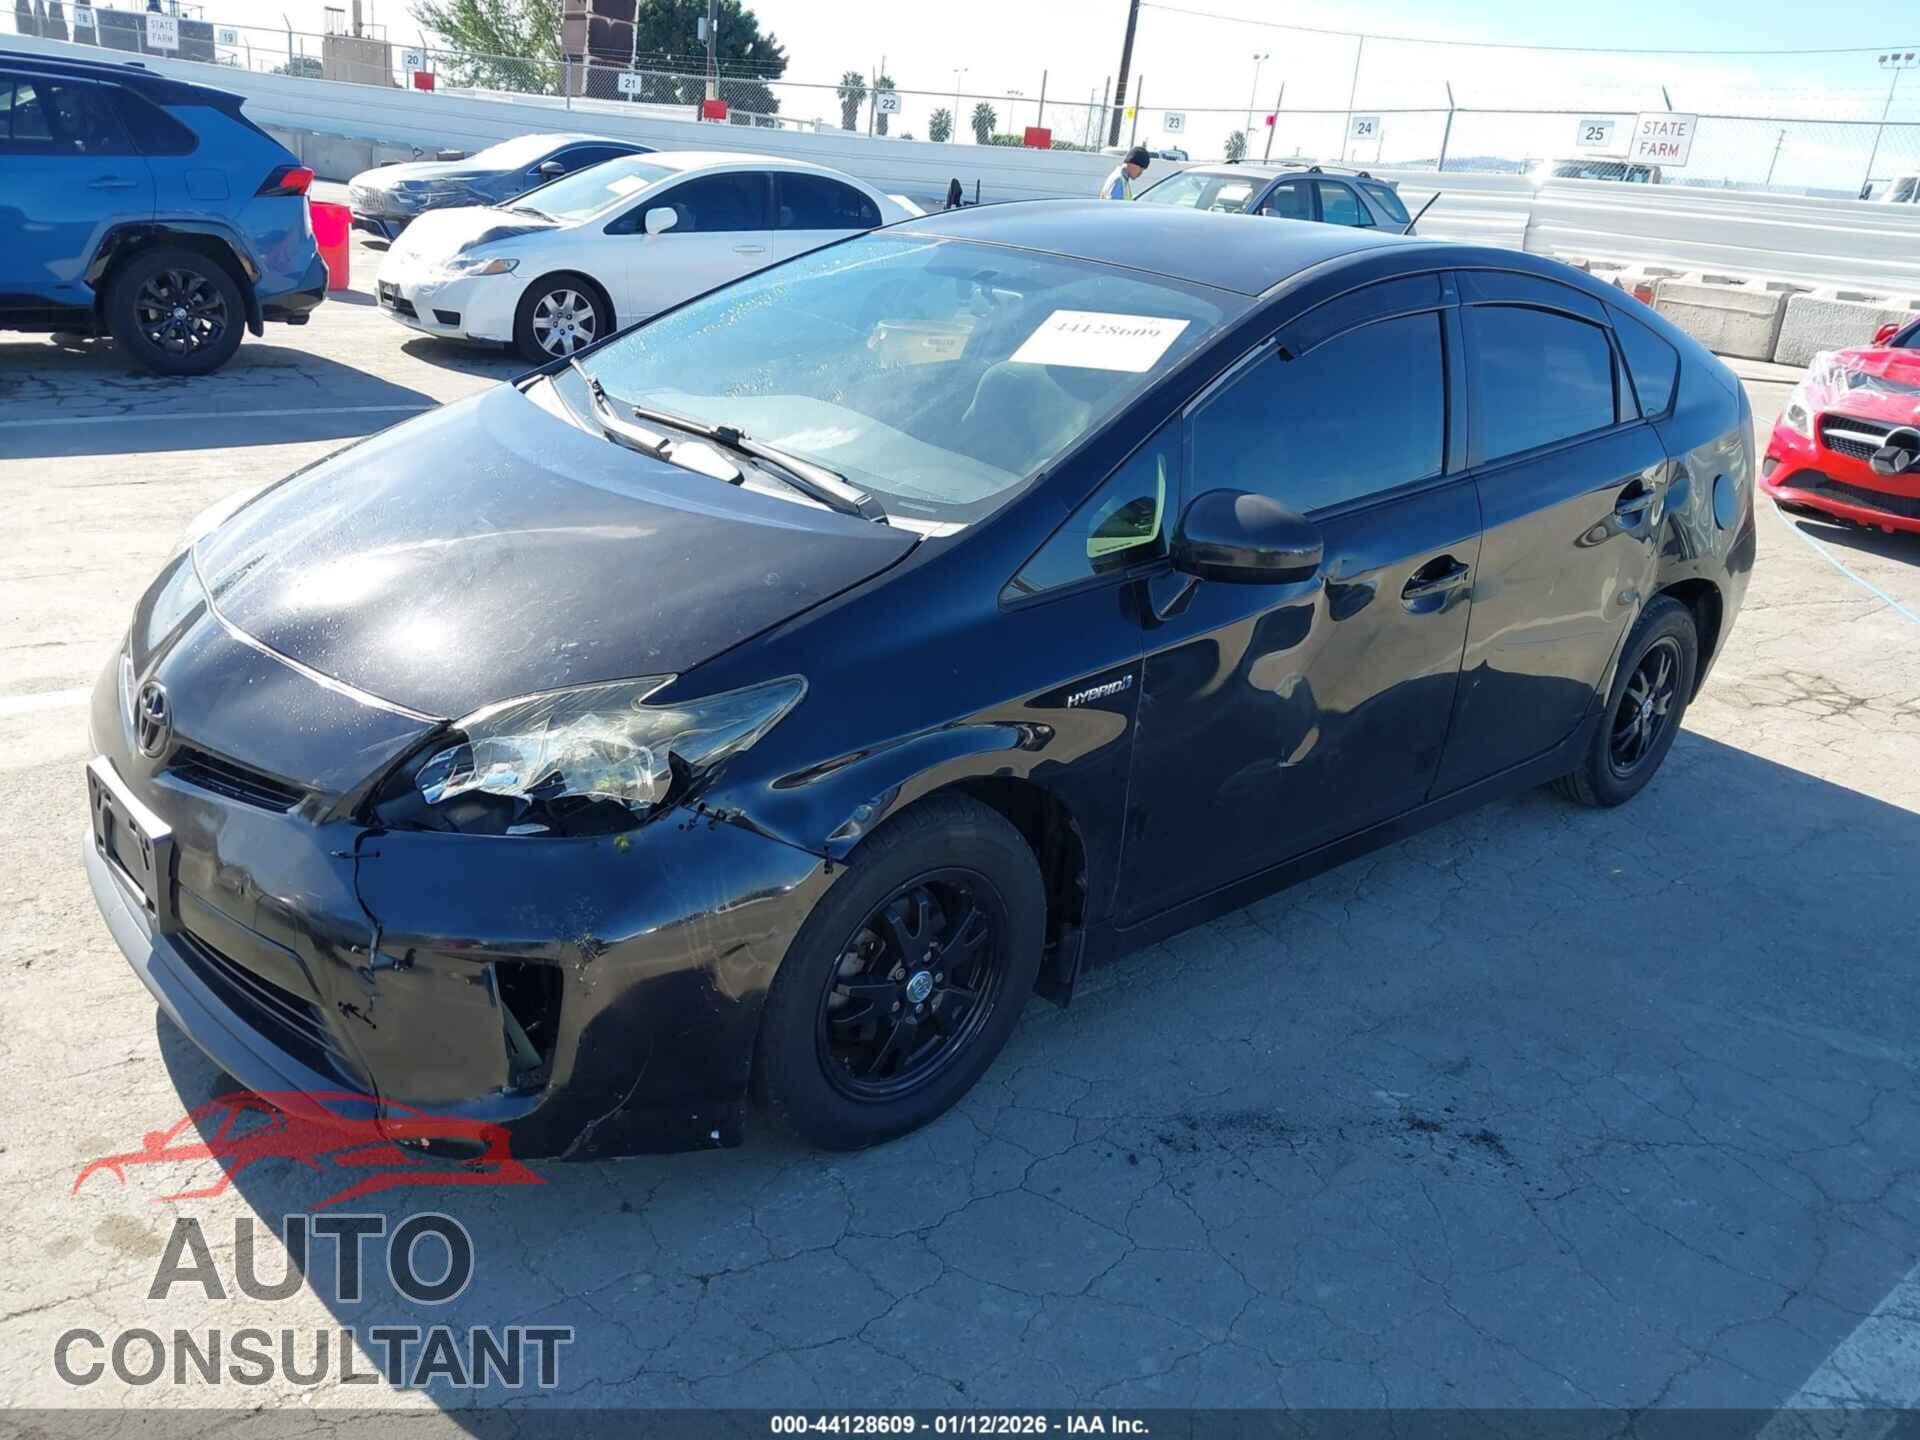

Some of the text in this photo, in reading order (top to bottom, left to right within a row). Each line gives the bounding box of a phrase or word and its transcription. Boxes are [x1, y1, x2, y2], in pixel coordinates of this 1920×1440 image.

[223, 32, 233, 42] 19
[407, 55, 419, 65] 20
[624, 78, 636, 89] 21
[882, 98, 896, 110] 22
[1168, 116, 1180, 129] 23
[1358, 122, 1372, 135] 24
[1642, 121, 1687, 137] STATE
[1585, 126, 1604, 141] 25
[1639, 142, 1680, 157] FARM
[1067, 680, 1123, 708] HYBRID
